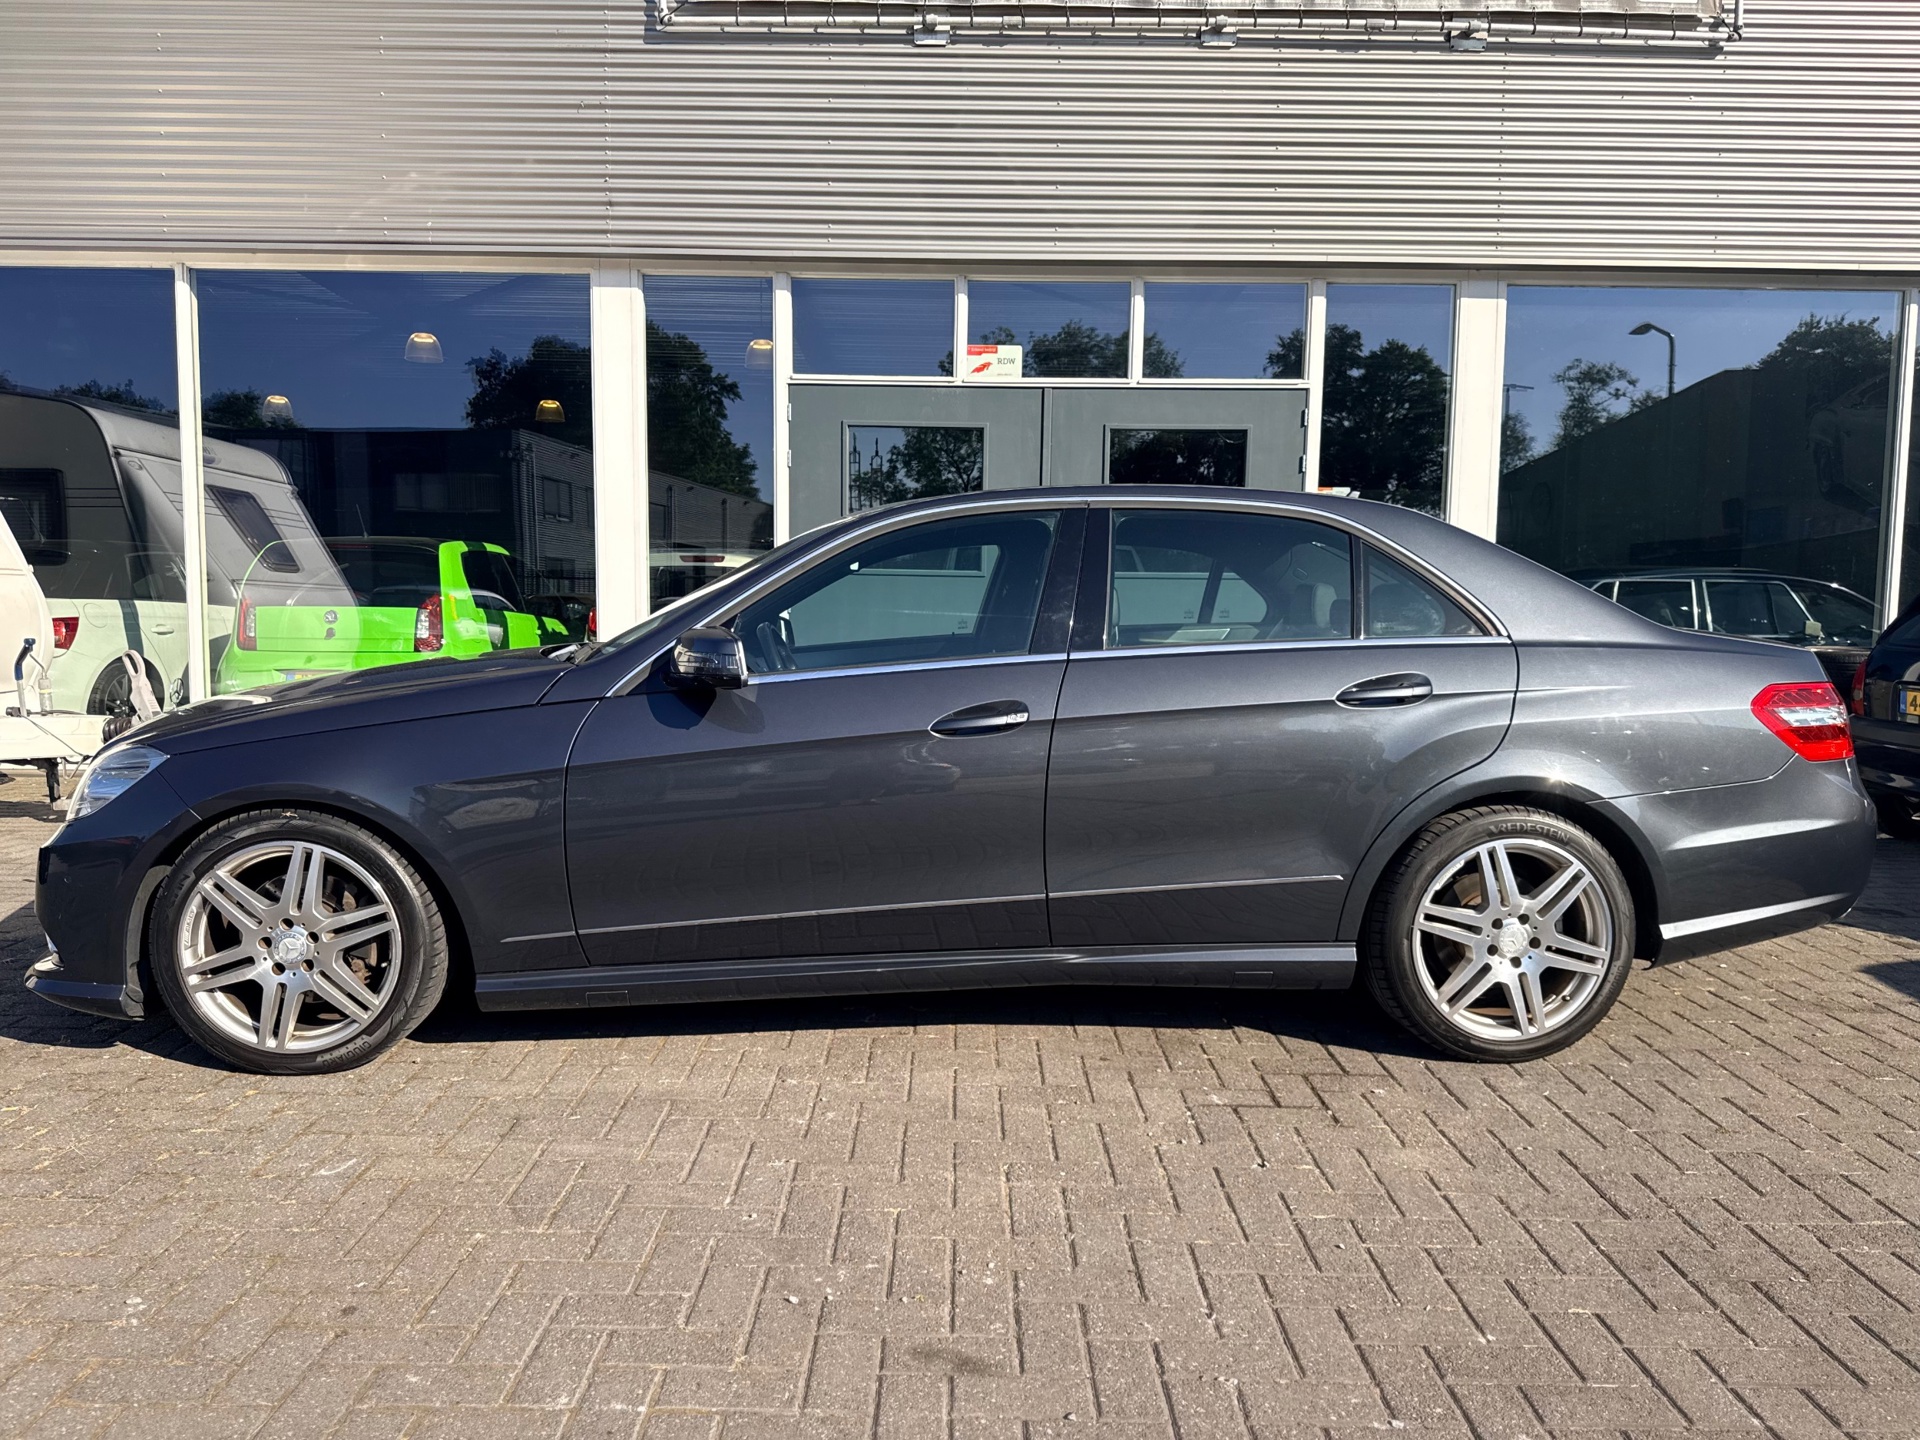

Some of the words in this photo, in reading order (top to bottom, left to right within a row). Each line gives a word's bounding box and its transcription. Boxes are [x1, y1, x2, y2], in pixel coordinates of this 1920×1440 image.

[1909, 695, 1920, 711] 4
[1489, 822, 1569, 842] VREDESTEIN
[322, 1041, 372, 1067] GIUGIARO
